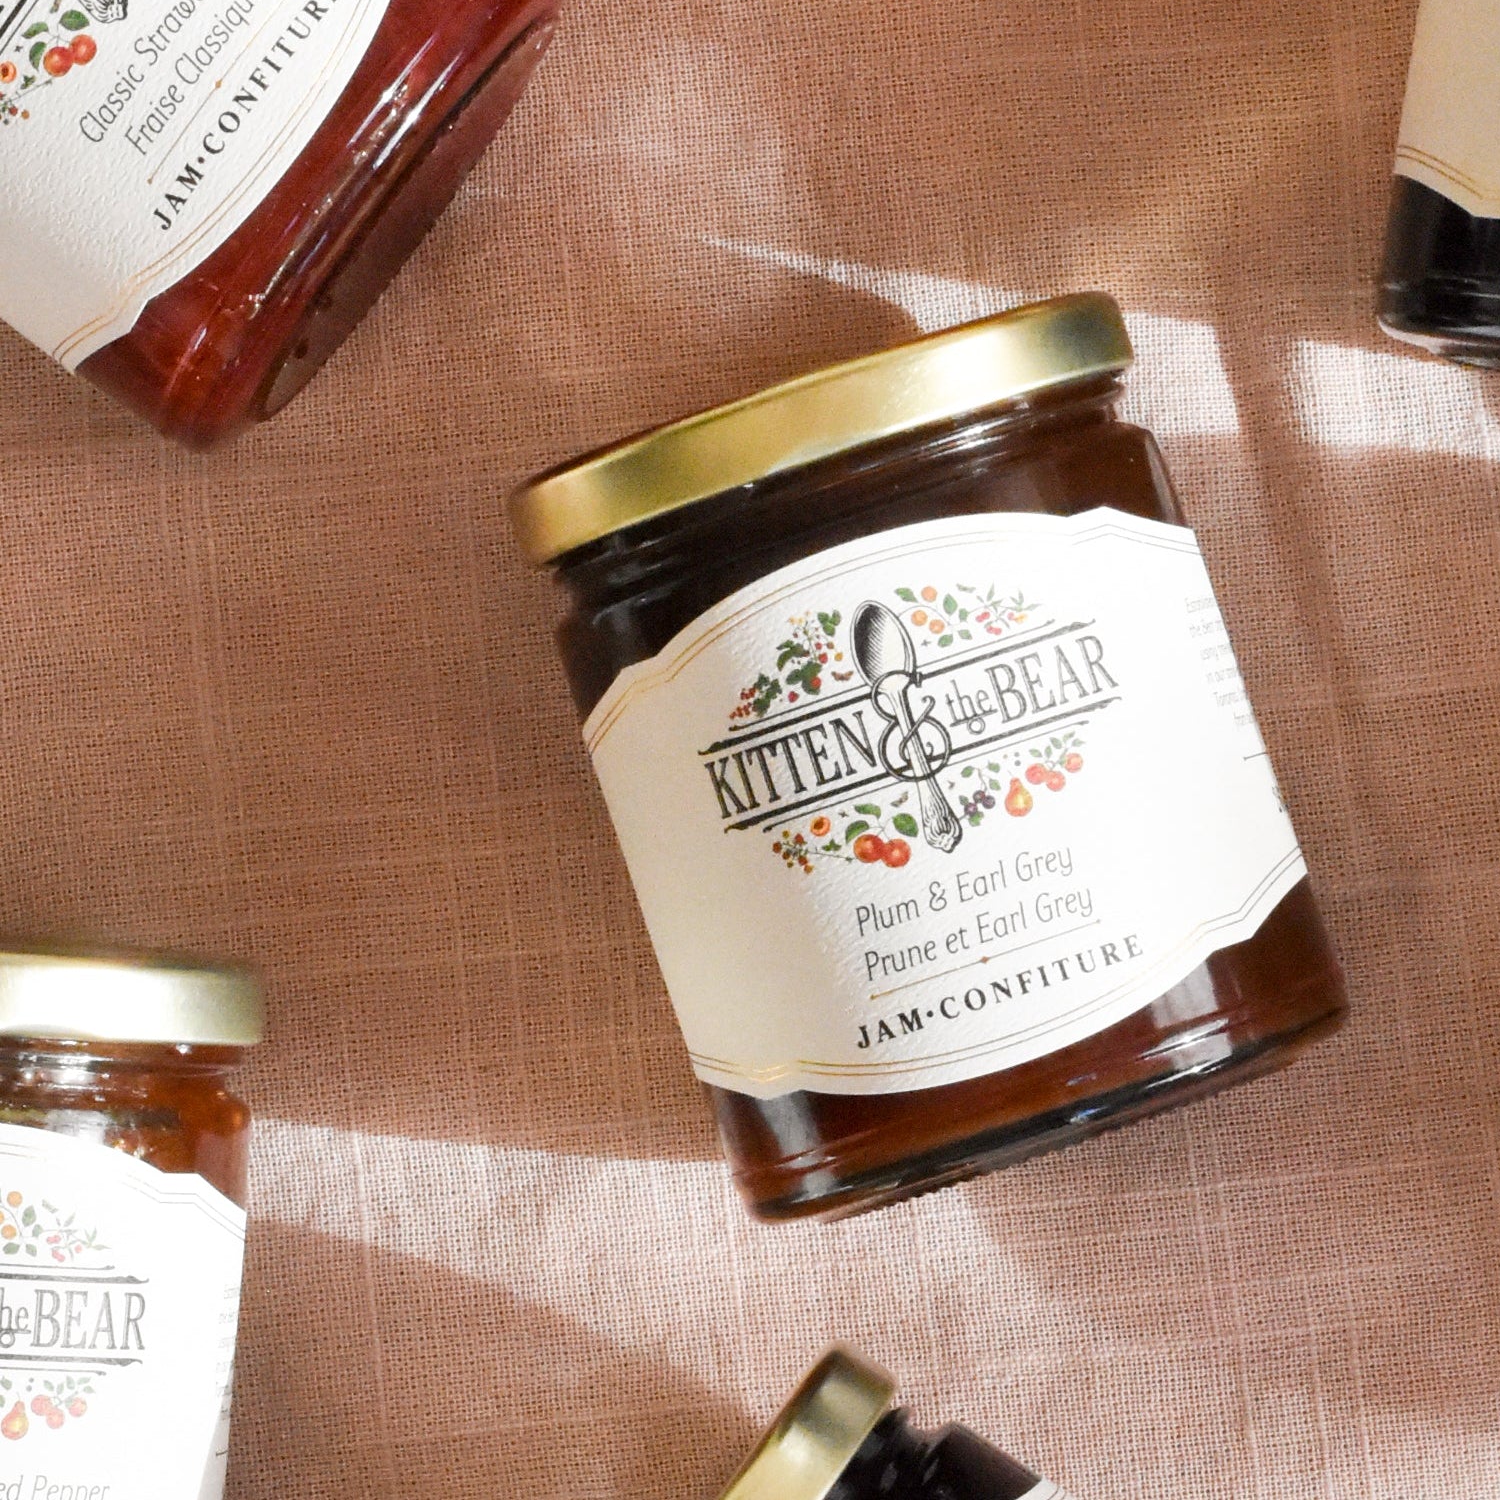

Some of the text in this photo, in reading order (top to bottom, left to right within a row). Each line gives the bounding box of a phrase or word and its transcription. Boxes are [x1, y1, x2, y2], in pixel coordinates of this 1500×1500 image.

[78, 63, 145, 143] Classic
[123, 84, 186, 156] Fraise
[703, 712, 878, 819] KITTEN
[945, 681, 997, 736] the
[988, 634, 1119, 724] BEAR
[855, 847, 1073, 938] Plum & Earl Grey
[864, 888, 1093, 982] Prune et Earl Grey
[30, 1289, 146, 1351] BEAR
